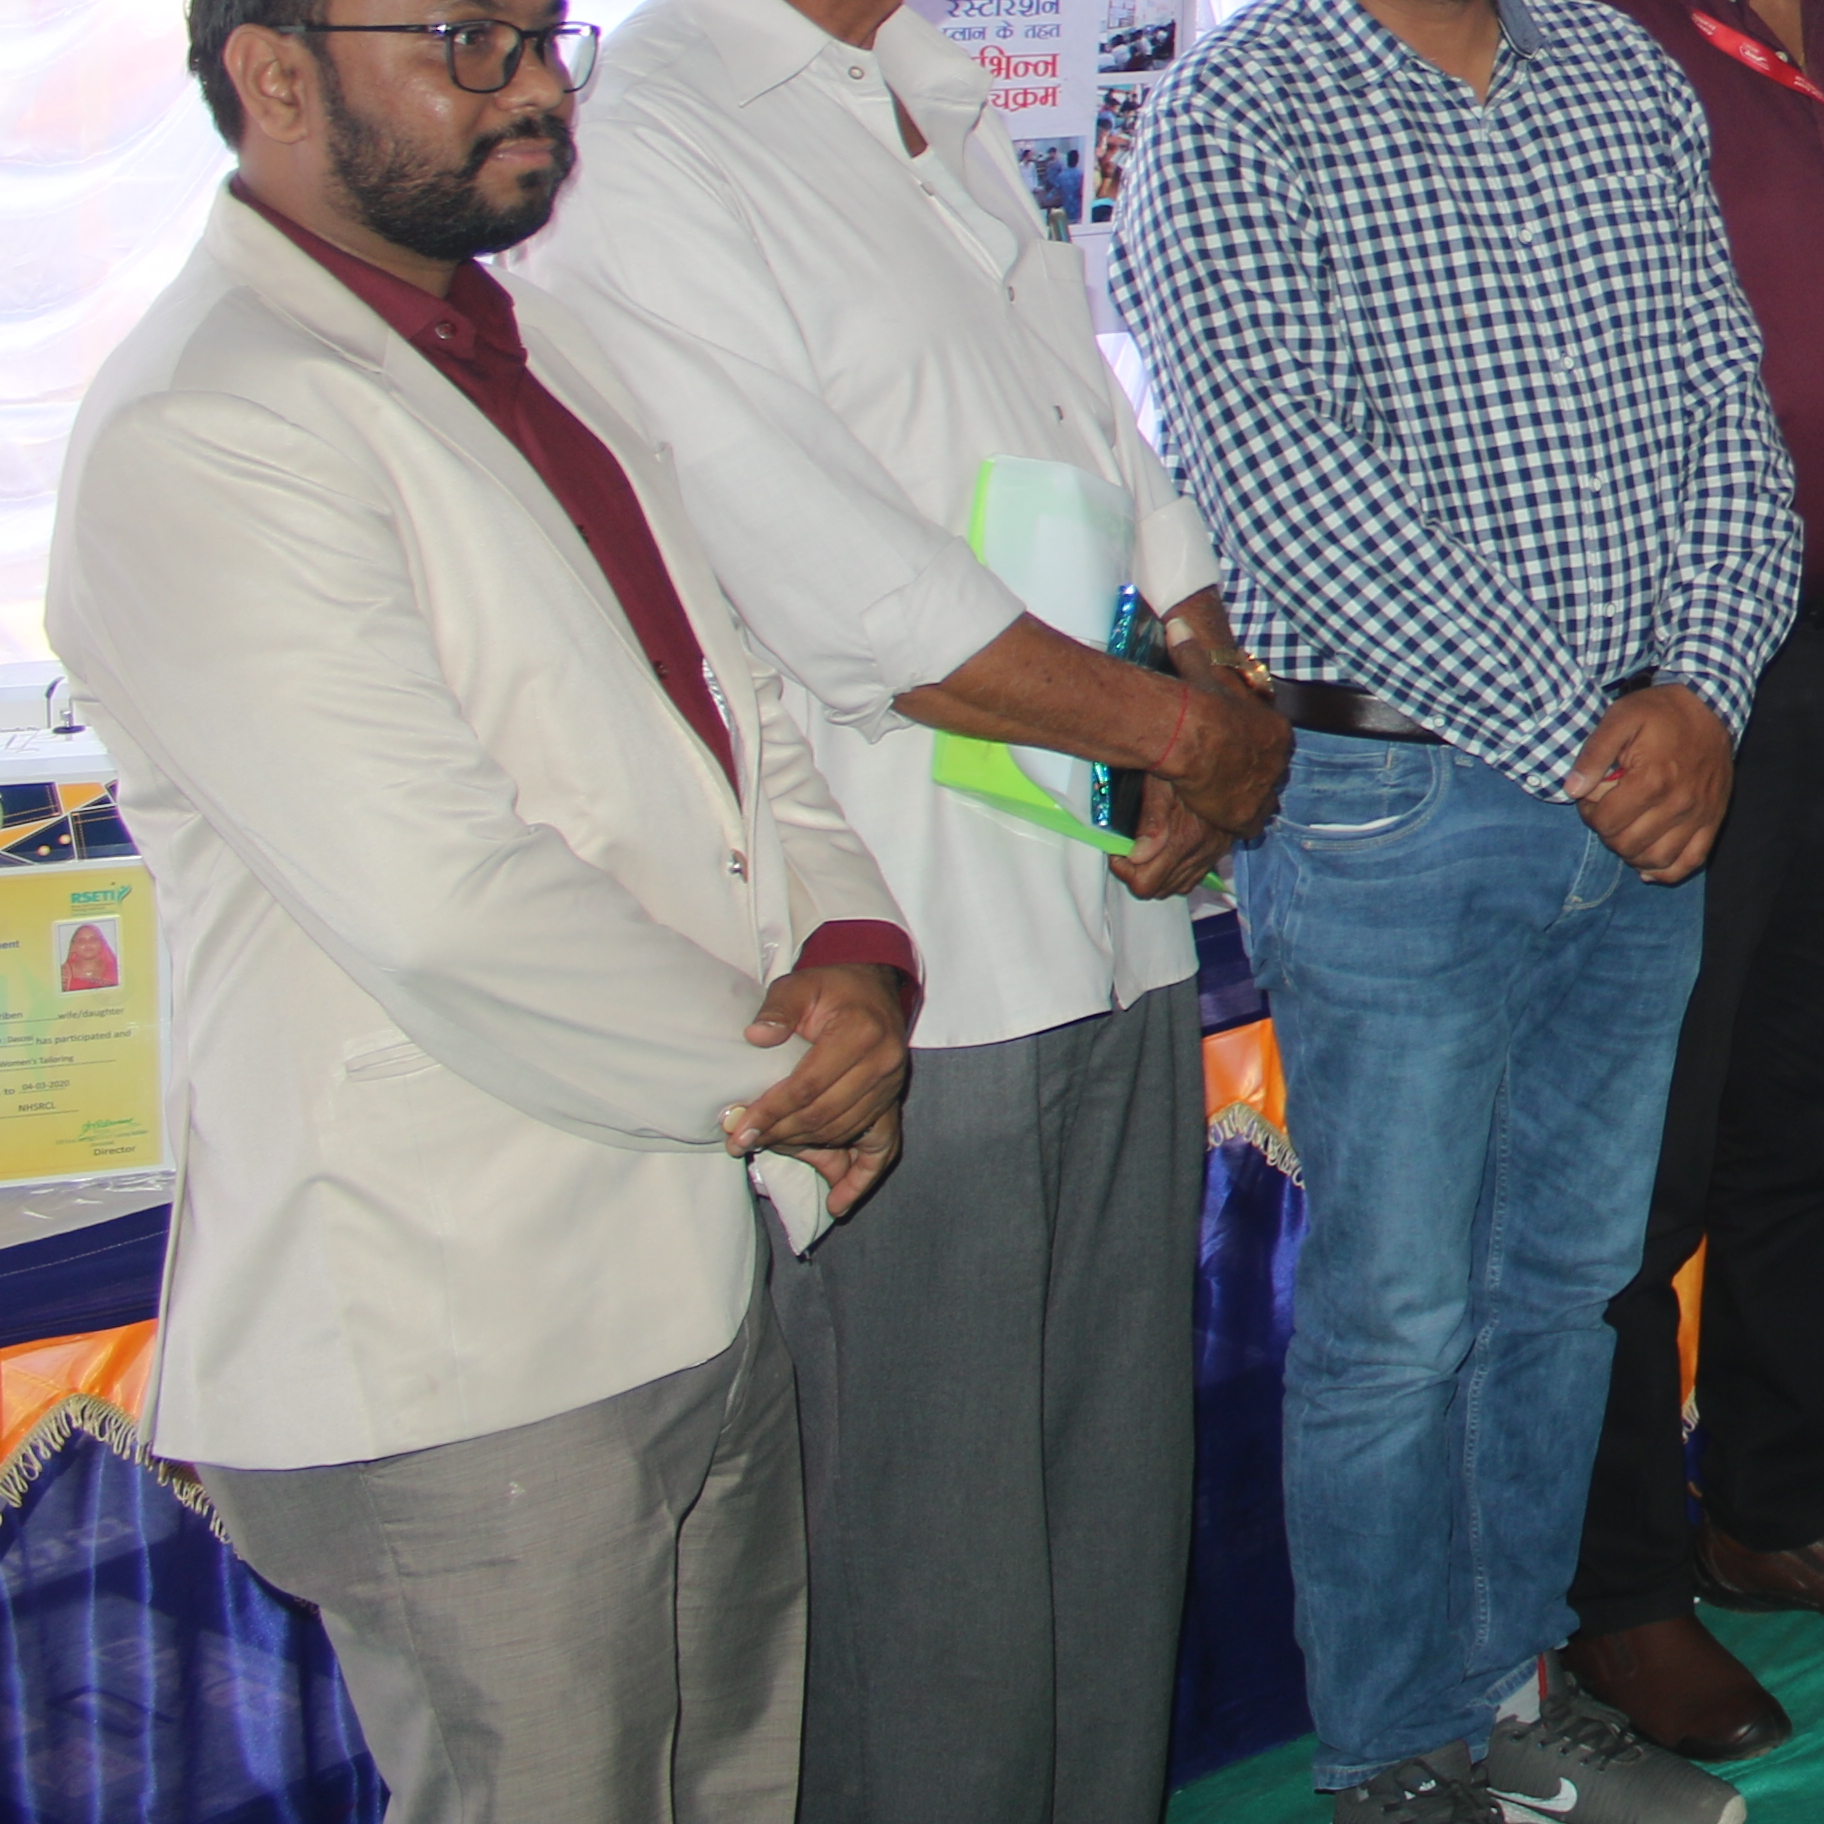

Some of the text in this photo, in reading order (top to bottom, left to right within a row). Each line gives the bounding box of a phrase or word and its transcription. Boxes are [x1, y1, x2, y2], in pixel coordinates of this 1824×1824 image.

[995, 20, 1014, 40] के
[1024, 24, 1062, 40] तहत
[971, 44, 1061, 80] भिन्न
[58, 1007, 125, 1020] wife/daughter
[36, 1036, 53, 1045] has
[54, 1030, 112, 1045] participated
[113, 1029, 132, 1038] and
[38, 1055, 75, 1064] Tailoring
[18, 1101, 56, 1112] NHSRCL
[93, 1145, 137, 1156] Director
